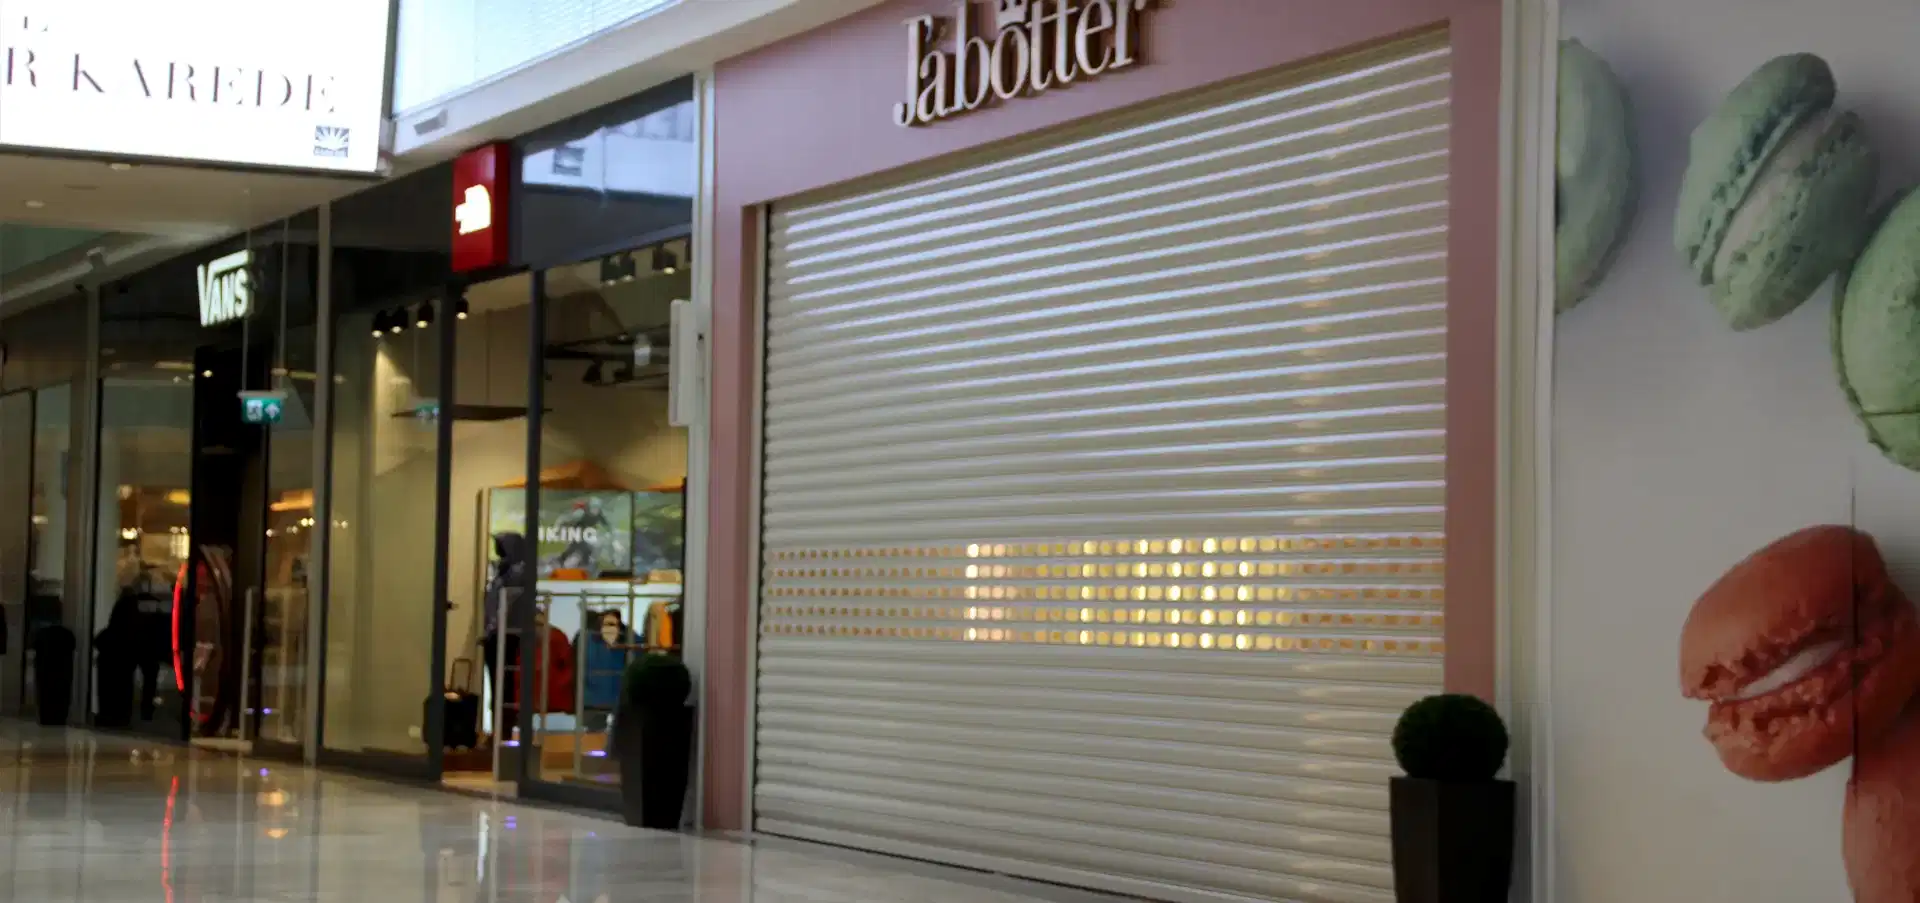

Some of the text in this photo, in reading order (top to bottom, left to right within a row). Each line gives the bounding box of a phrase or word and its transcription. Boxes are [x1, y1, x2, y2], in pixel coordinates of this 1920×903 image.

[72, 53, 336, 113] KAREDE
[197, 249, 248, 327] VANS
[537, 526, 598, 543] IKING
